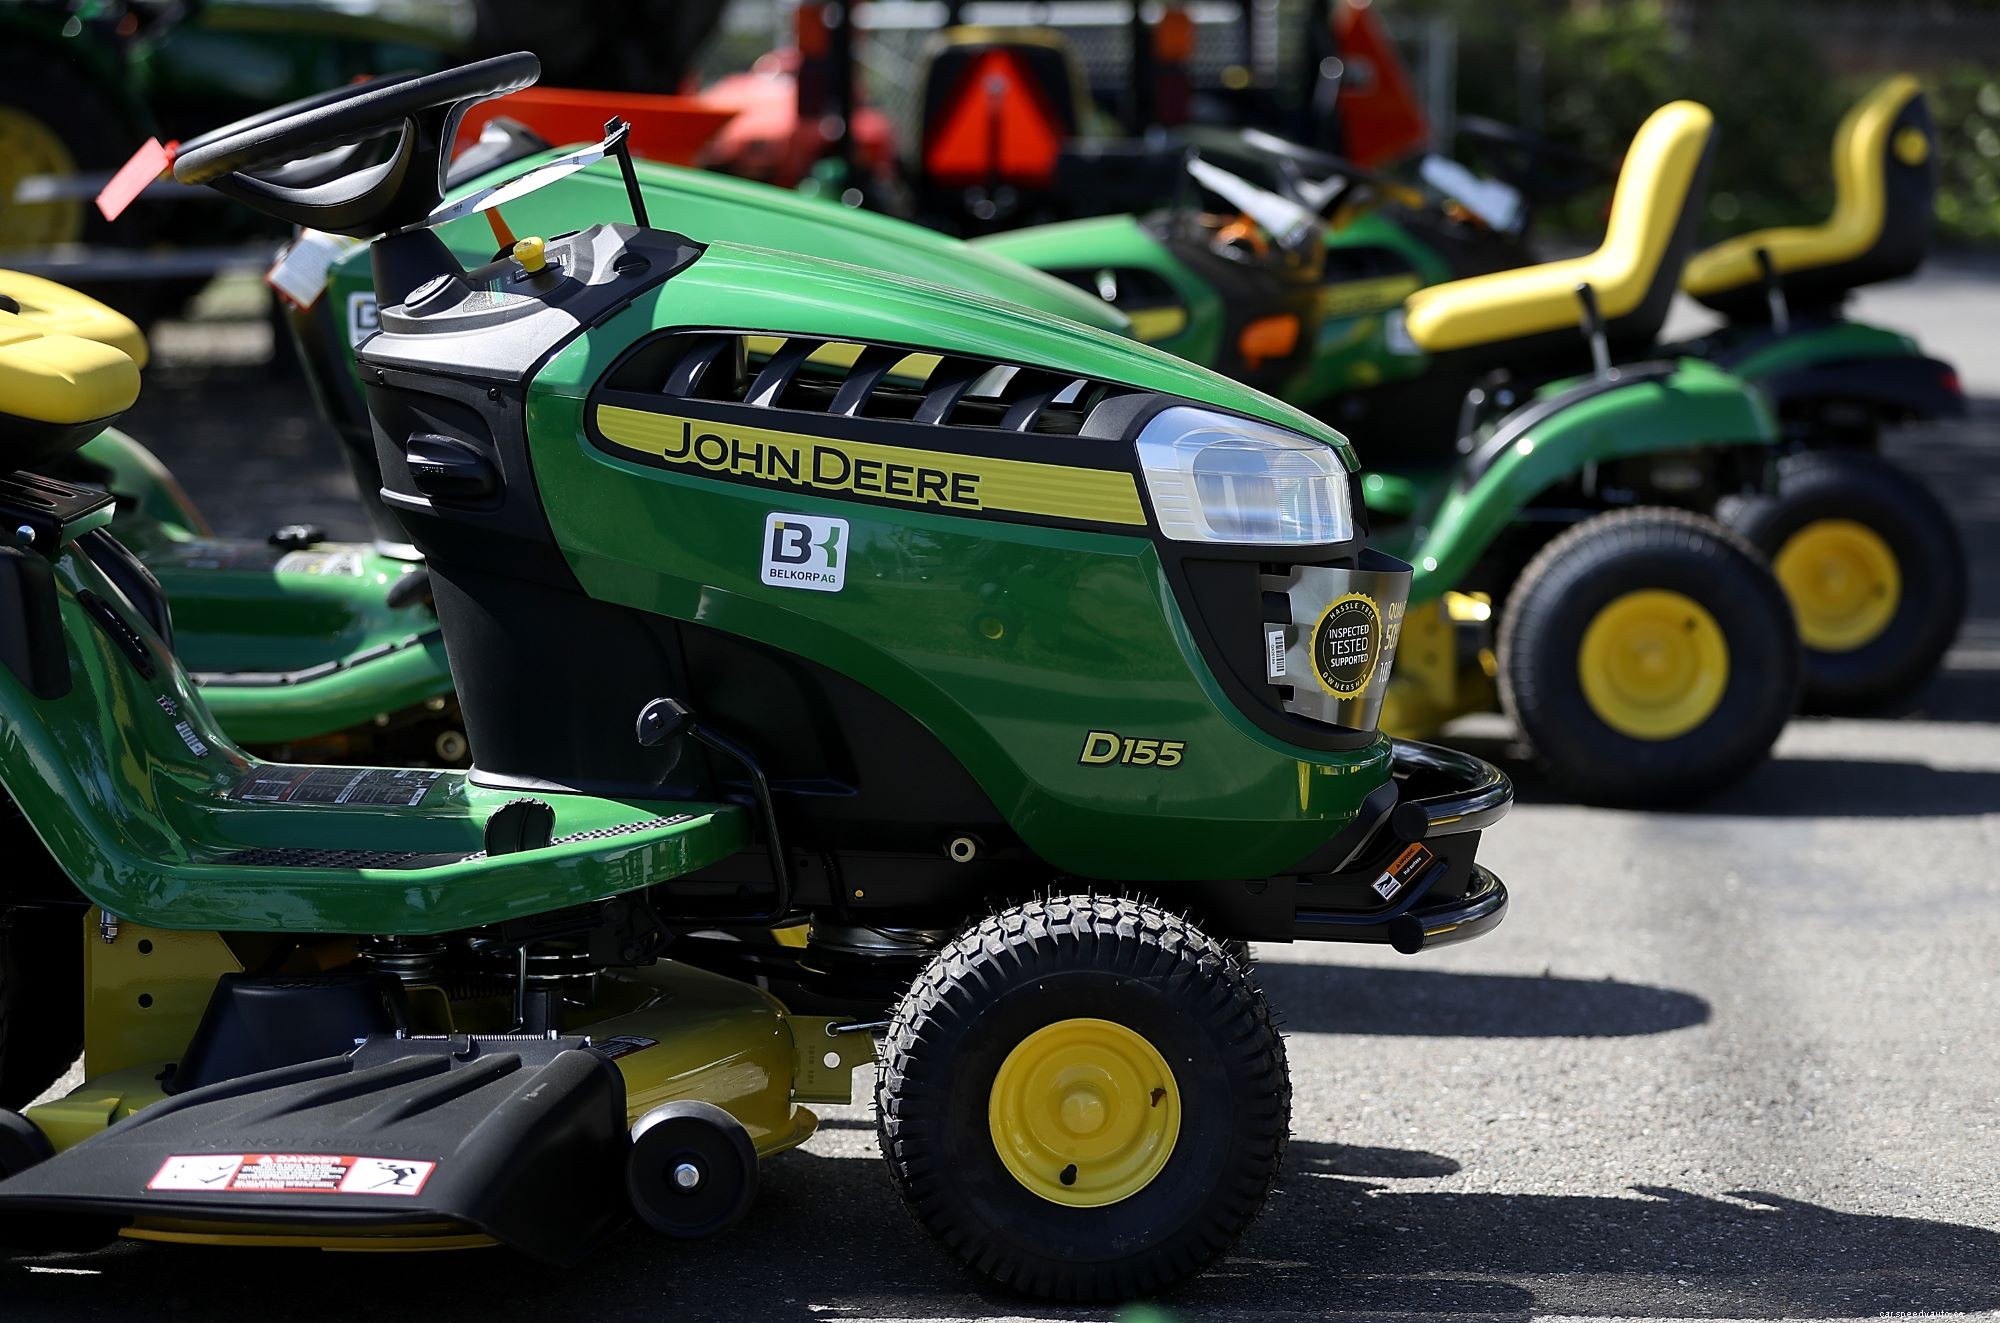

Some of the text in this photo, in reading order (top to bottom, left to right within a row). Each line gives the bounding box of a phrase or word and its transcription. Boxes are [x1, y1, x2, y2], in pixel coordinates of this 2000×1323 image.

[664, 422, 982, 507] JOHN DEERE
[769, 568, 836, 584] BELKORP AG
[1329, 602, 1376, 621] HASSLE FREE
[1329, 624, 1370, 639] INSPECTED
[1330, 637, 1369, 655] TESTED
[1330, 653, 1369, 668] SUPPORTED
[1322, 671, 1367, 691] OWNERSHIP
[1079, 730, 1186, 767] D155
